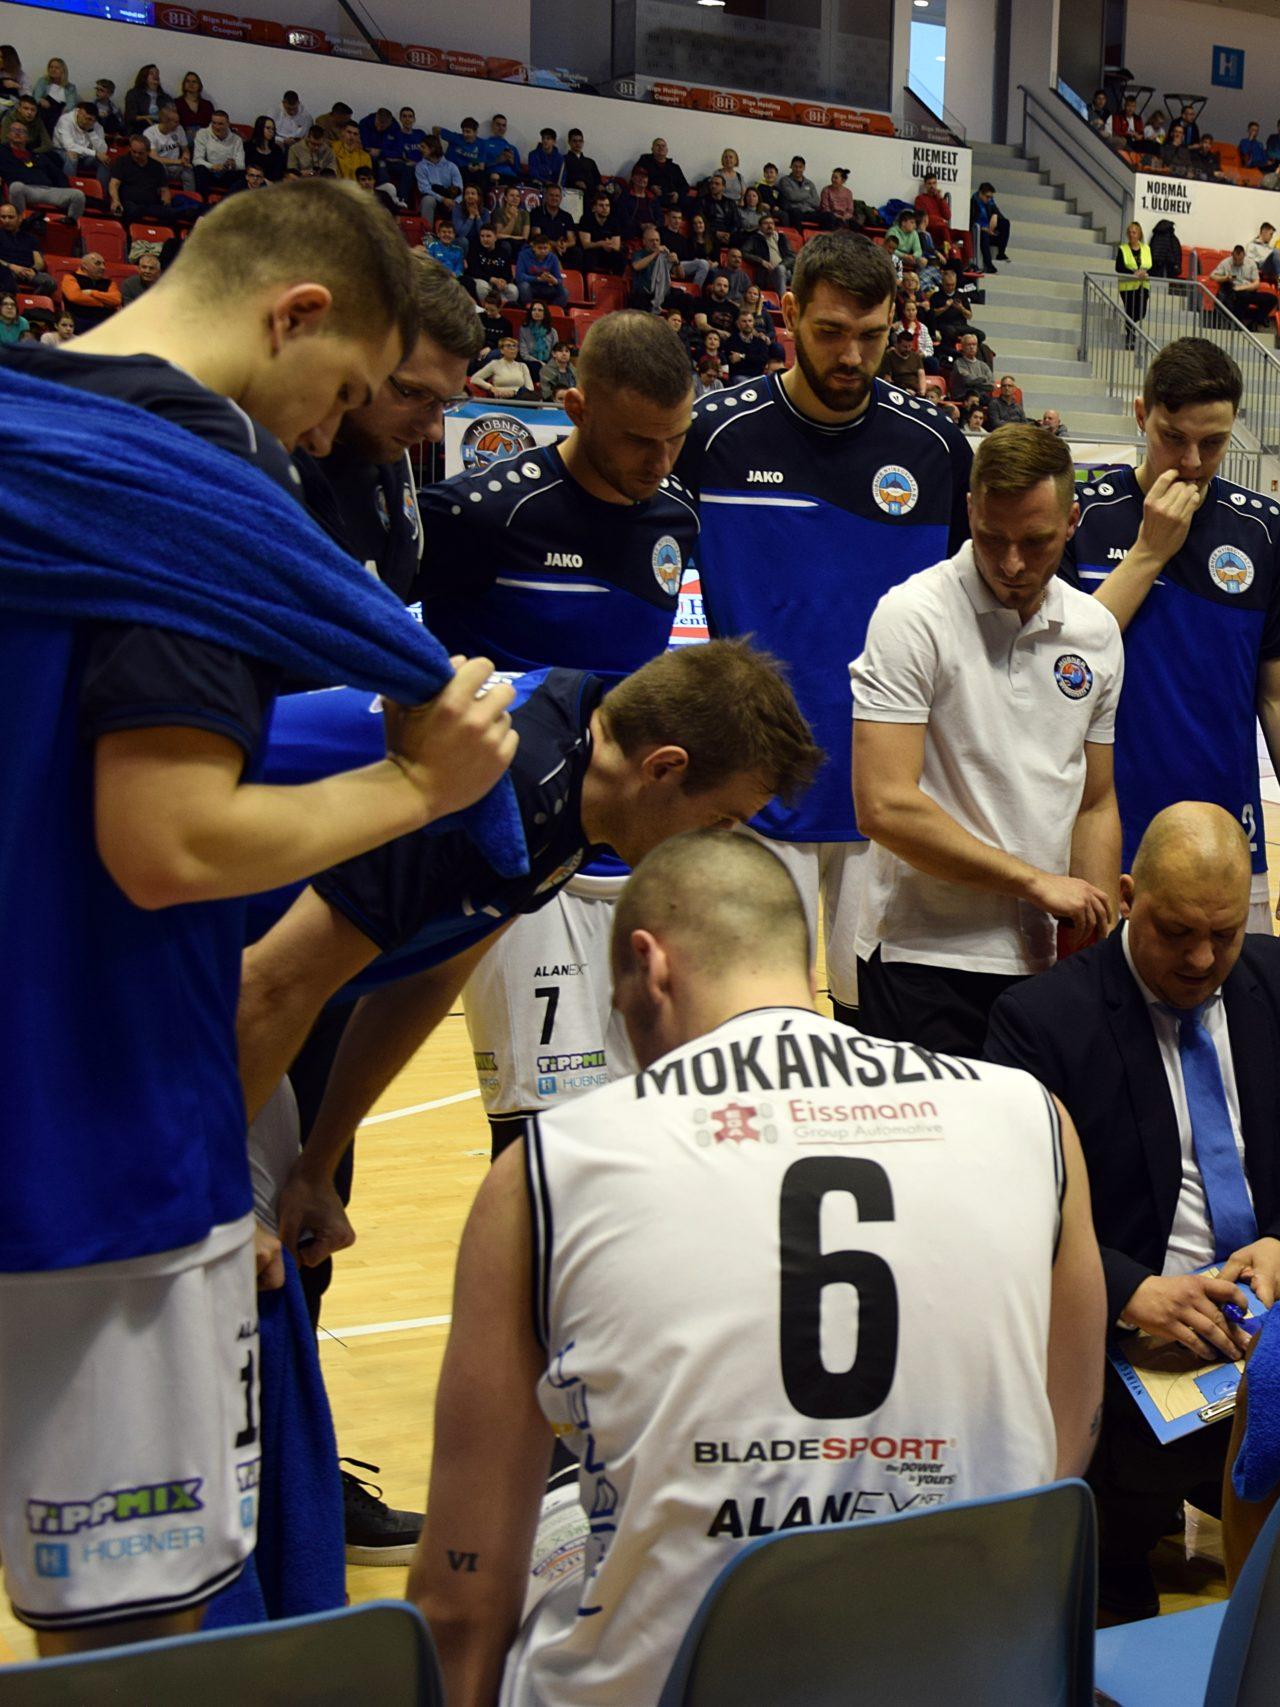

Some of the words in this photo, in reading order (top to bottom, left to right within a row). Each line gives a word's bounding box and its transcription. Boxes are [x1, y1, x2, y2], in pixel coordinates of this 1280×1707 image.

[913, 147, 958, 166] KIEMELT
[912, 161, 958, 182] ÜLŐHELY
[1147, 181, 1188, 198] NORMÁL
[1142, 196, 1149, 209] 1.
[1151, 195, 1192, 214] ÜLŐHELY
[473, 420, 529, 440] HÜBNER
[746, 470, 784, 484] JAKO
[544, 552, 583, 568] JAKO
[534, 986, 560, 1046] 7
[537, 1050, 607, 1074] TiPPMI
[788, 1099, 938, 1123] Eissmann
[793, 1125, 848, 1141] Group
[854, 1122, 943, 1137] Automotive
[779, 1155, 899, 1420] 6
[694, 1436, 946, 1464] BLADESPORT
[900, 1462, 944, 1475] power
[916, 1474, 957, 1487] yours
[81, 1525, 205, 1564] HÜBNER
[446, 1550, 479, 1573] VI
